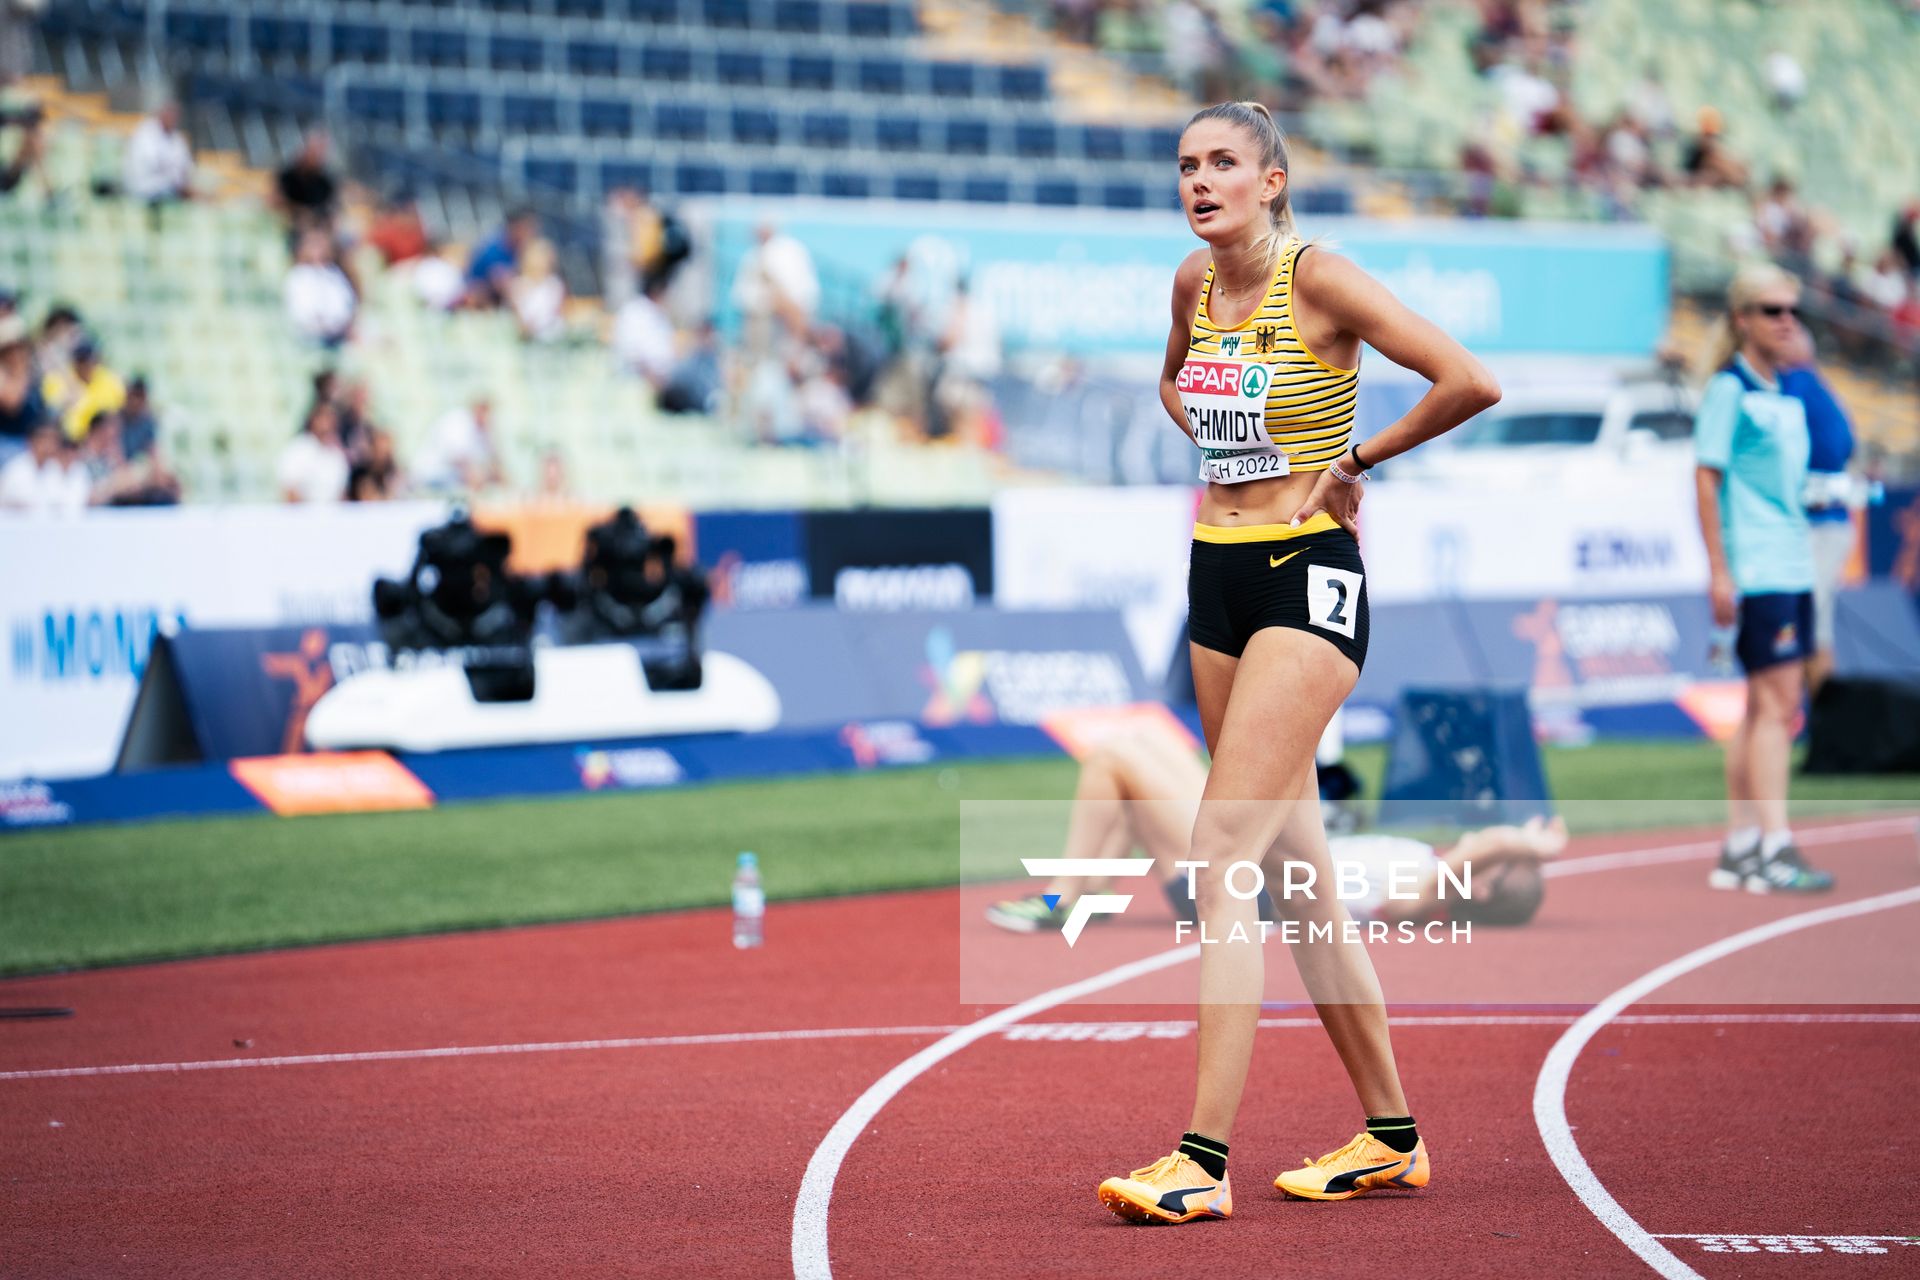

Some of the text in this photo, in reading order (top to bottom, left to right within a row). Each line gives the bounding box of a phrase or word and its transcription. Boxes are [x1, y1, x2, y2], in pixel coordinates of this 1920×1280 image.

[1221, 336, 1241, 357] wgv
[1178, 365, 1240, 392] SPAR
[1236, 454, 1281, 477] 2022
[1326, 578, 1348, 627] 2
